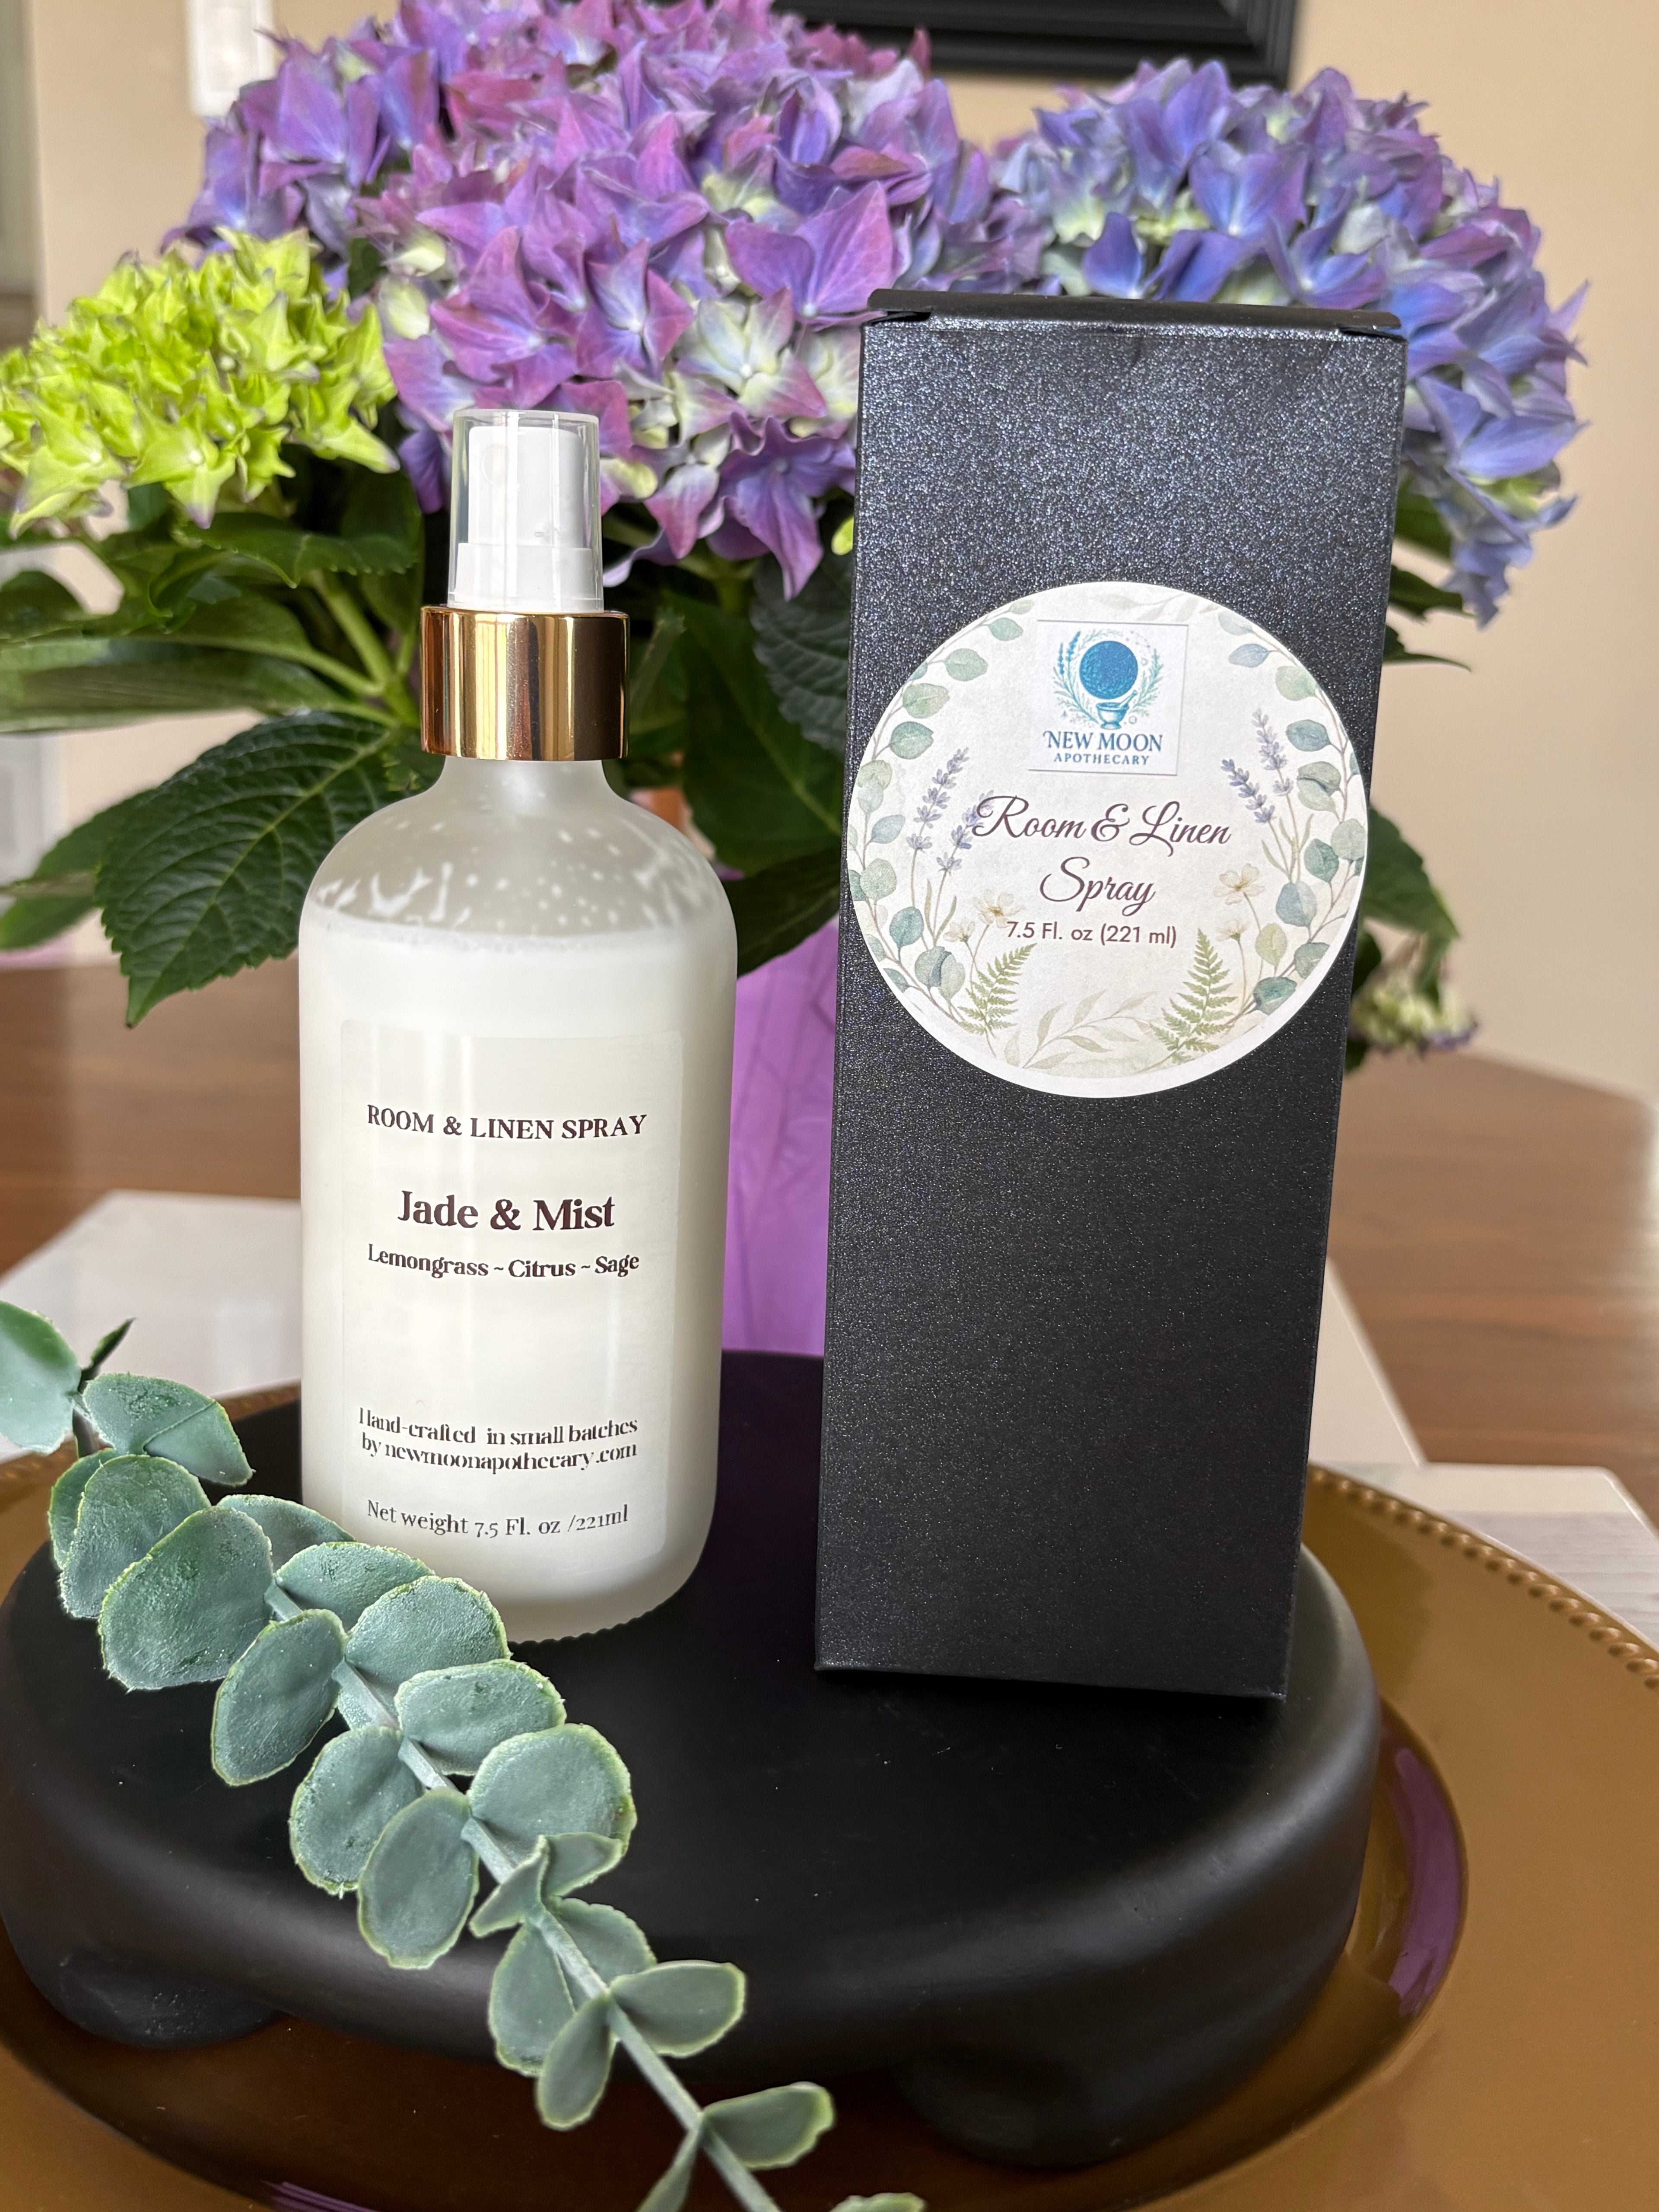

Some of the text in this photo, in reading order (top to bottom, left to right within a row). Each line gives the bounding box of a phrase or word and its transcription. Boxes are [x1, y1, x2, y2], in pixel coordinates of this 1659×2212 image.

[1042, 730, 1163, 753] NEW MOON
[1054, 753, 1150, 766] APOTHECARY
[971, 795, 1232, 857] Room & Linen
[1040, 857, 1157, 916] Spray
[1007, 922, 1177, 948] 7.5 Fl. oz (221 ml)
[367, 1105, 647, 1139] ROOM & LINEN SPRAY
[397, 1191, 615, 1231] Jade & Mist
[368, 1243, 489, 1278] Lemongrass
[508, 1259, 576, 1278] Citrus
[594, 1254, 639, 1278] Sage
[486, 1427, 505, 1445] in
[510, 1426, 564, 1445] small
[568, 1417, 638, 1442] batches
[362, 1432, 638, 1475] by newmoonapothecary.com
[367, 1500, 629, 1538] Net weight 7.5 Fl. oz /221ml
